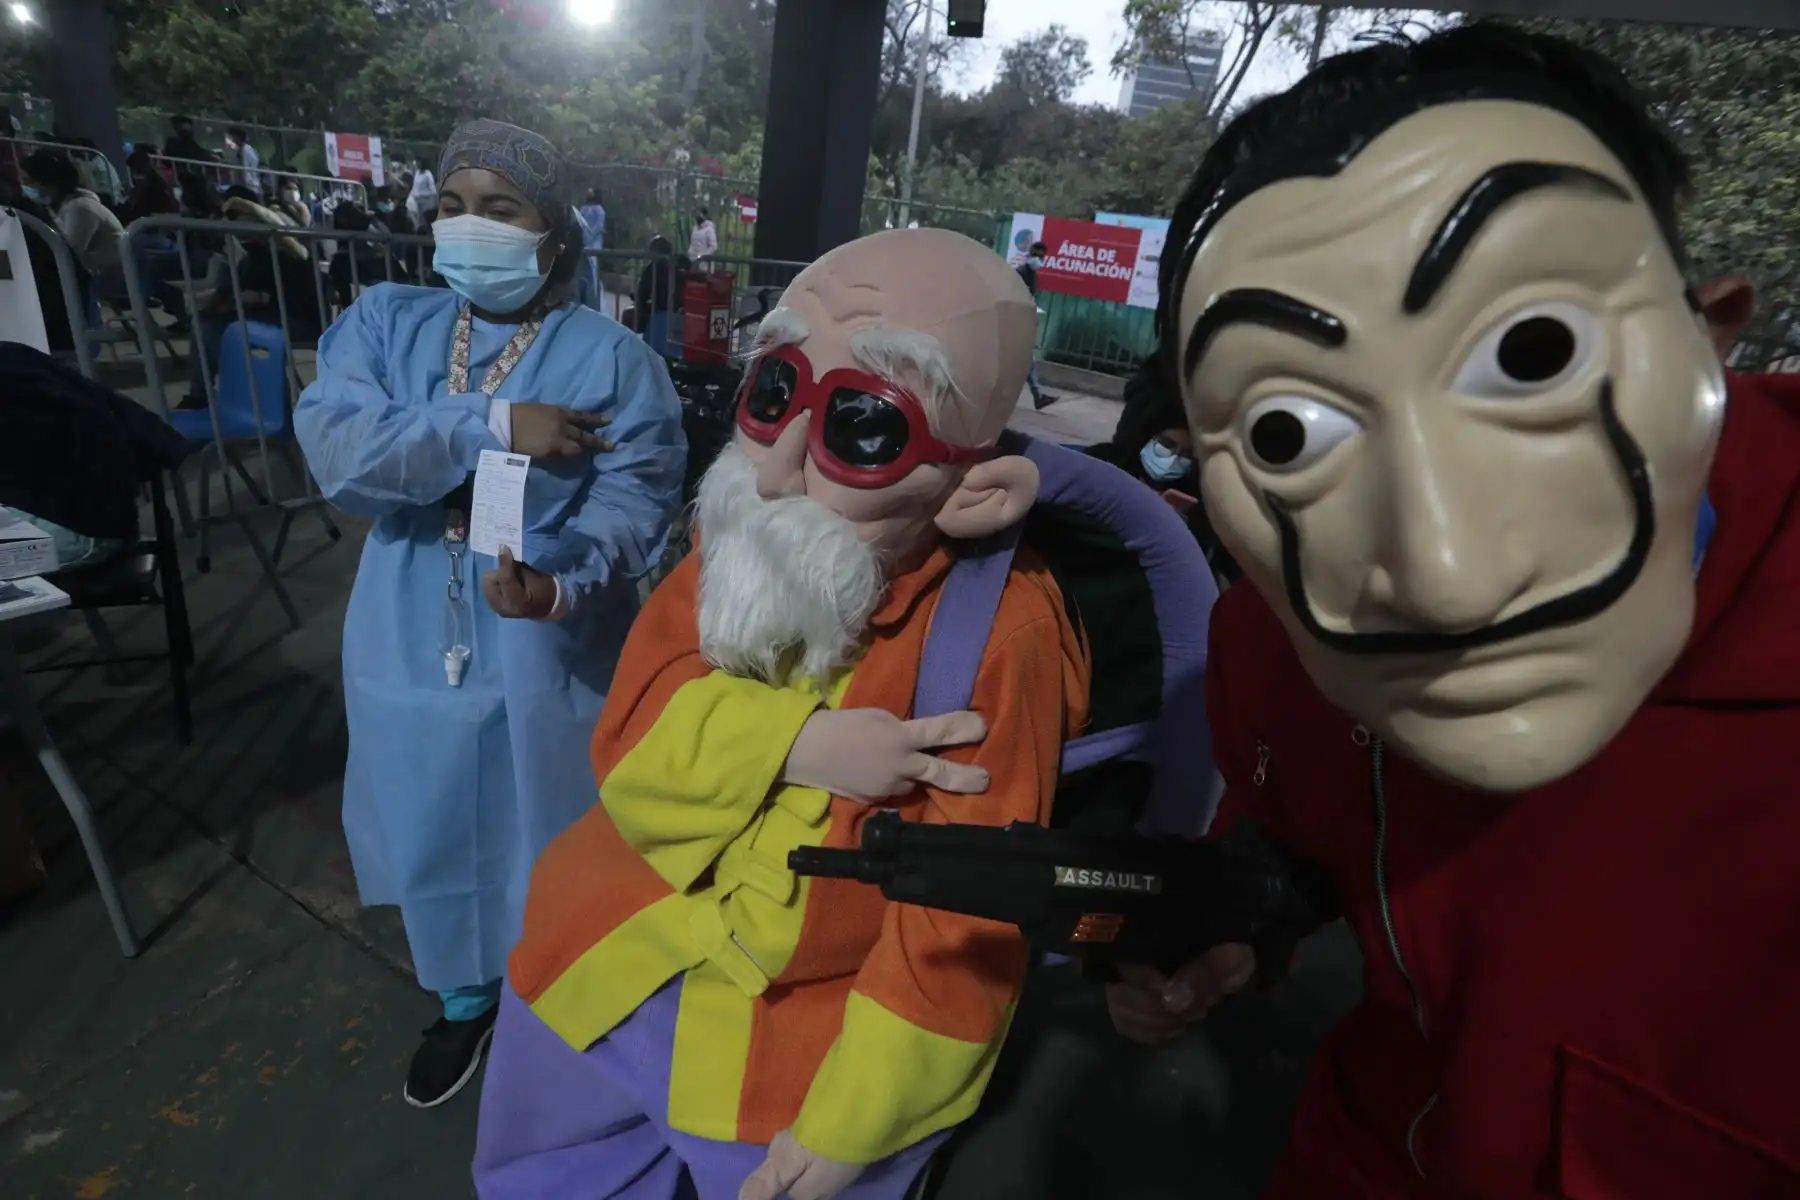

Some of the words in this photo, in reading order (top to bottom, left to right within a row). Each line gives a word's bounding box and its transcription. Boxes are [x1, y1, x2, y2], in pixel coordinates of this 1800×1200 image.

[1057, 240, 1094, 260] ÁREA
[1097, 247, 1117, 263] DE
[1063, 868, 1155, 890] ASSAULT
